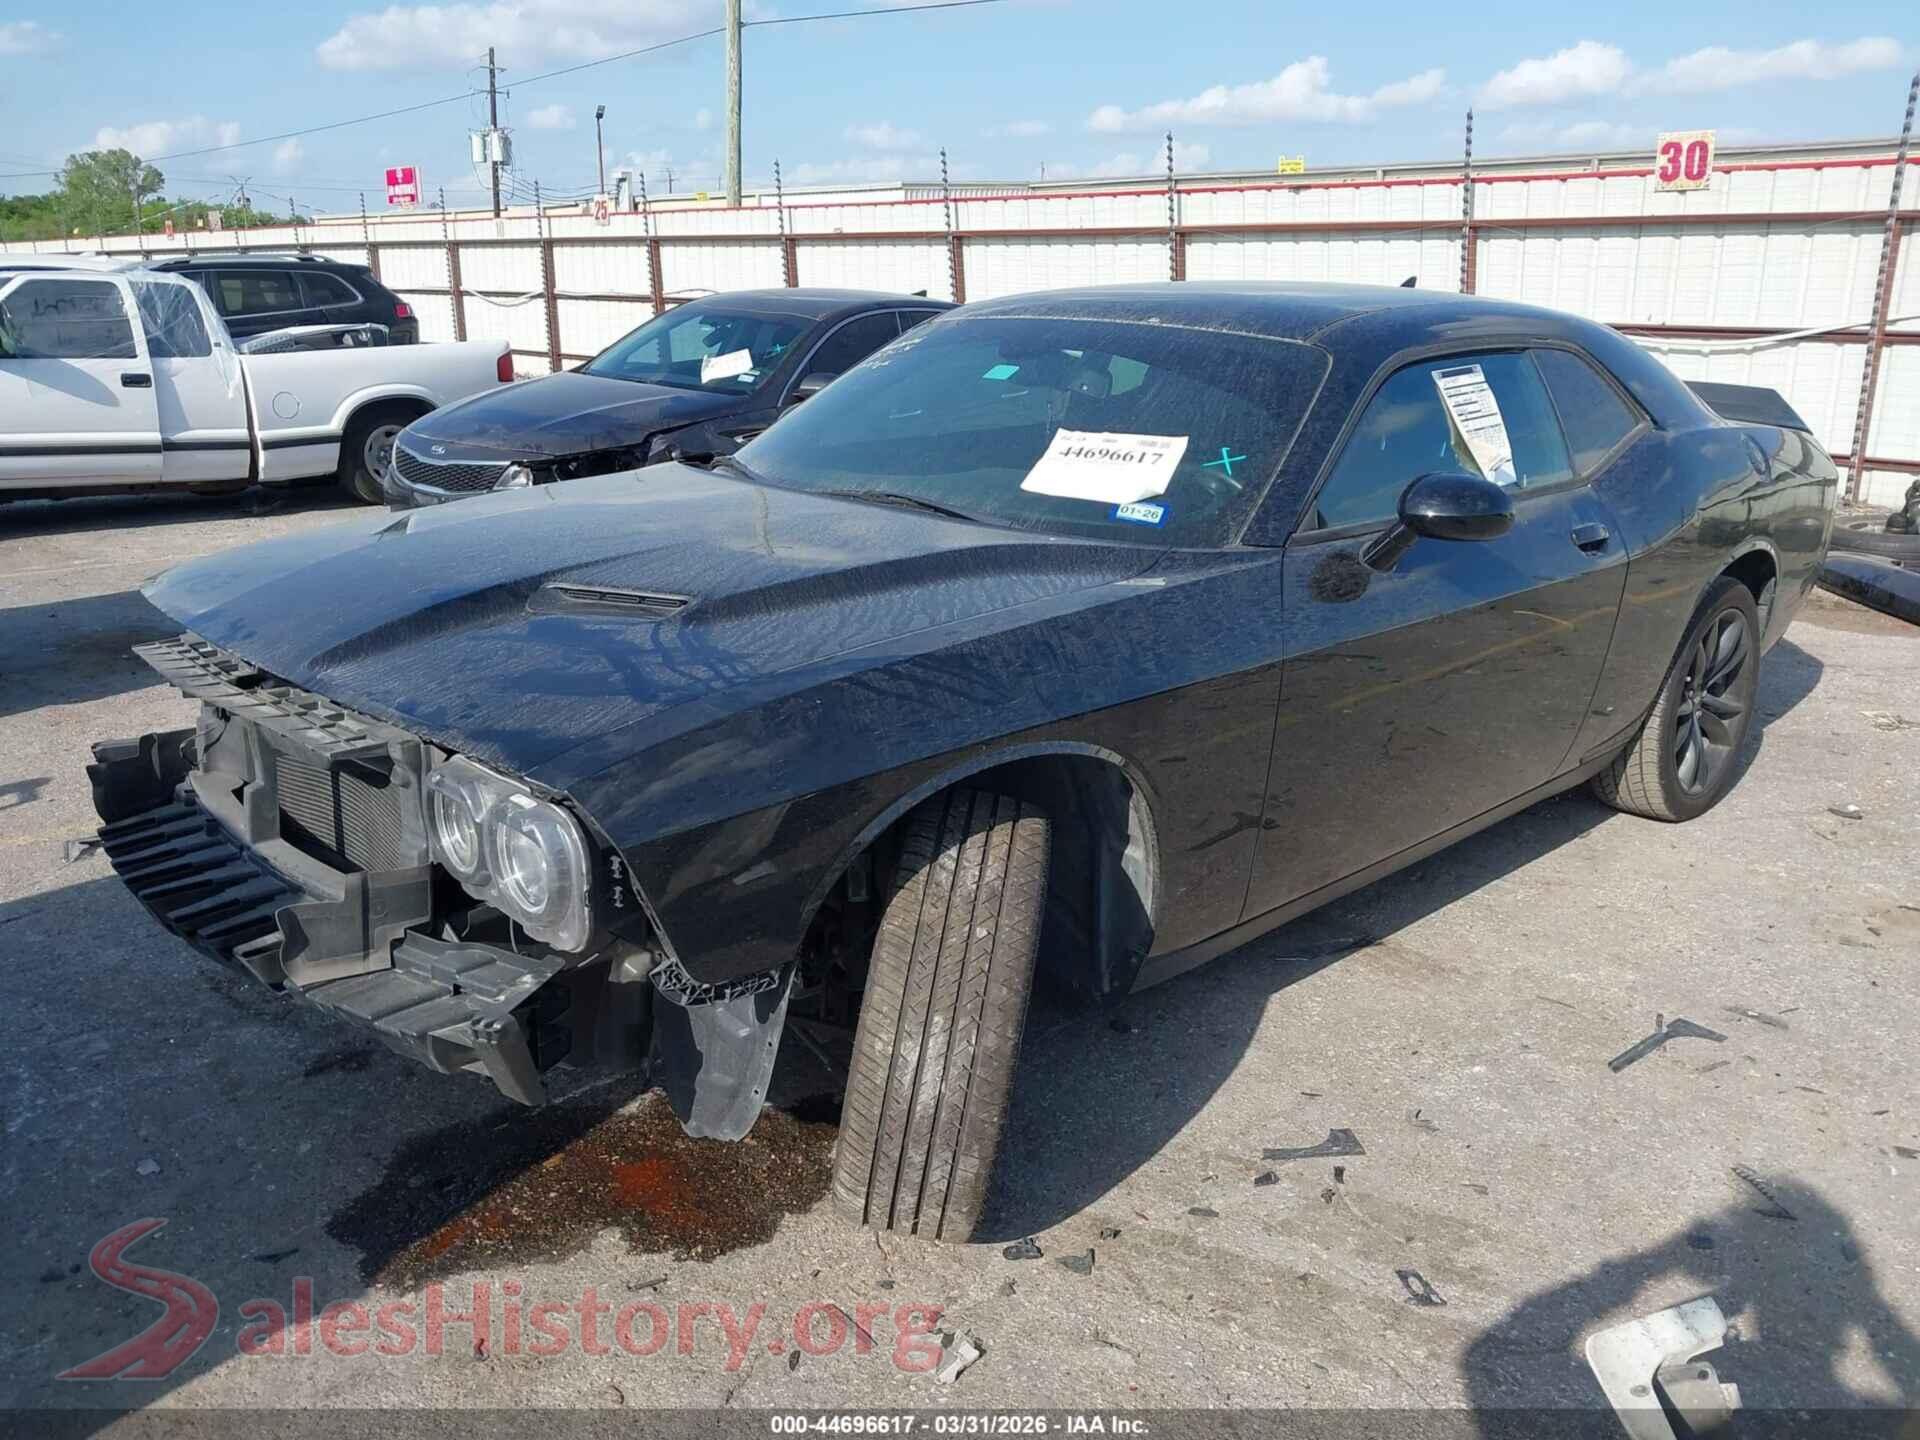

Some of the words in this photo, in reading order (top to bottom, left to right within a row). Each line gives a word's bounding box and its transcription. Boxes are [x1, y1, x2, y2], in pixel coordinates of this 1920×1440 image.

[1659, 140, 1709, 182] 30
[594, 200, 608, 220] 25
[1059, 446, 1164, 465] 44696617
